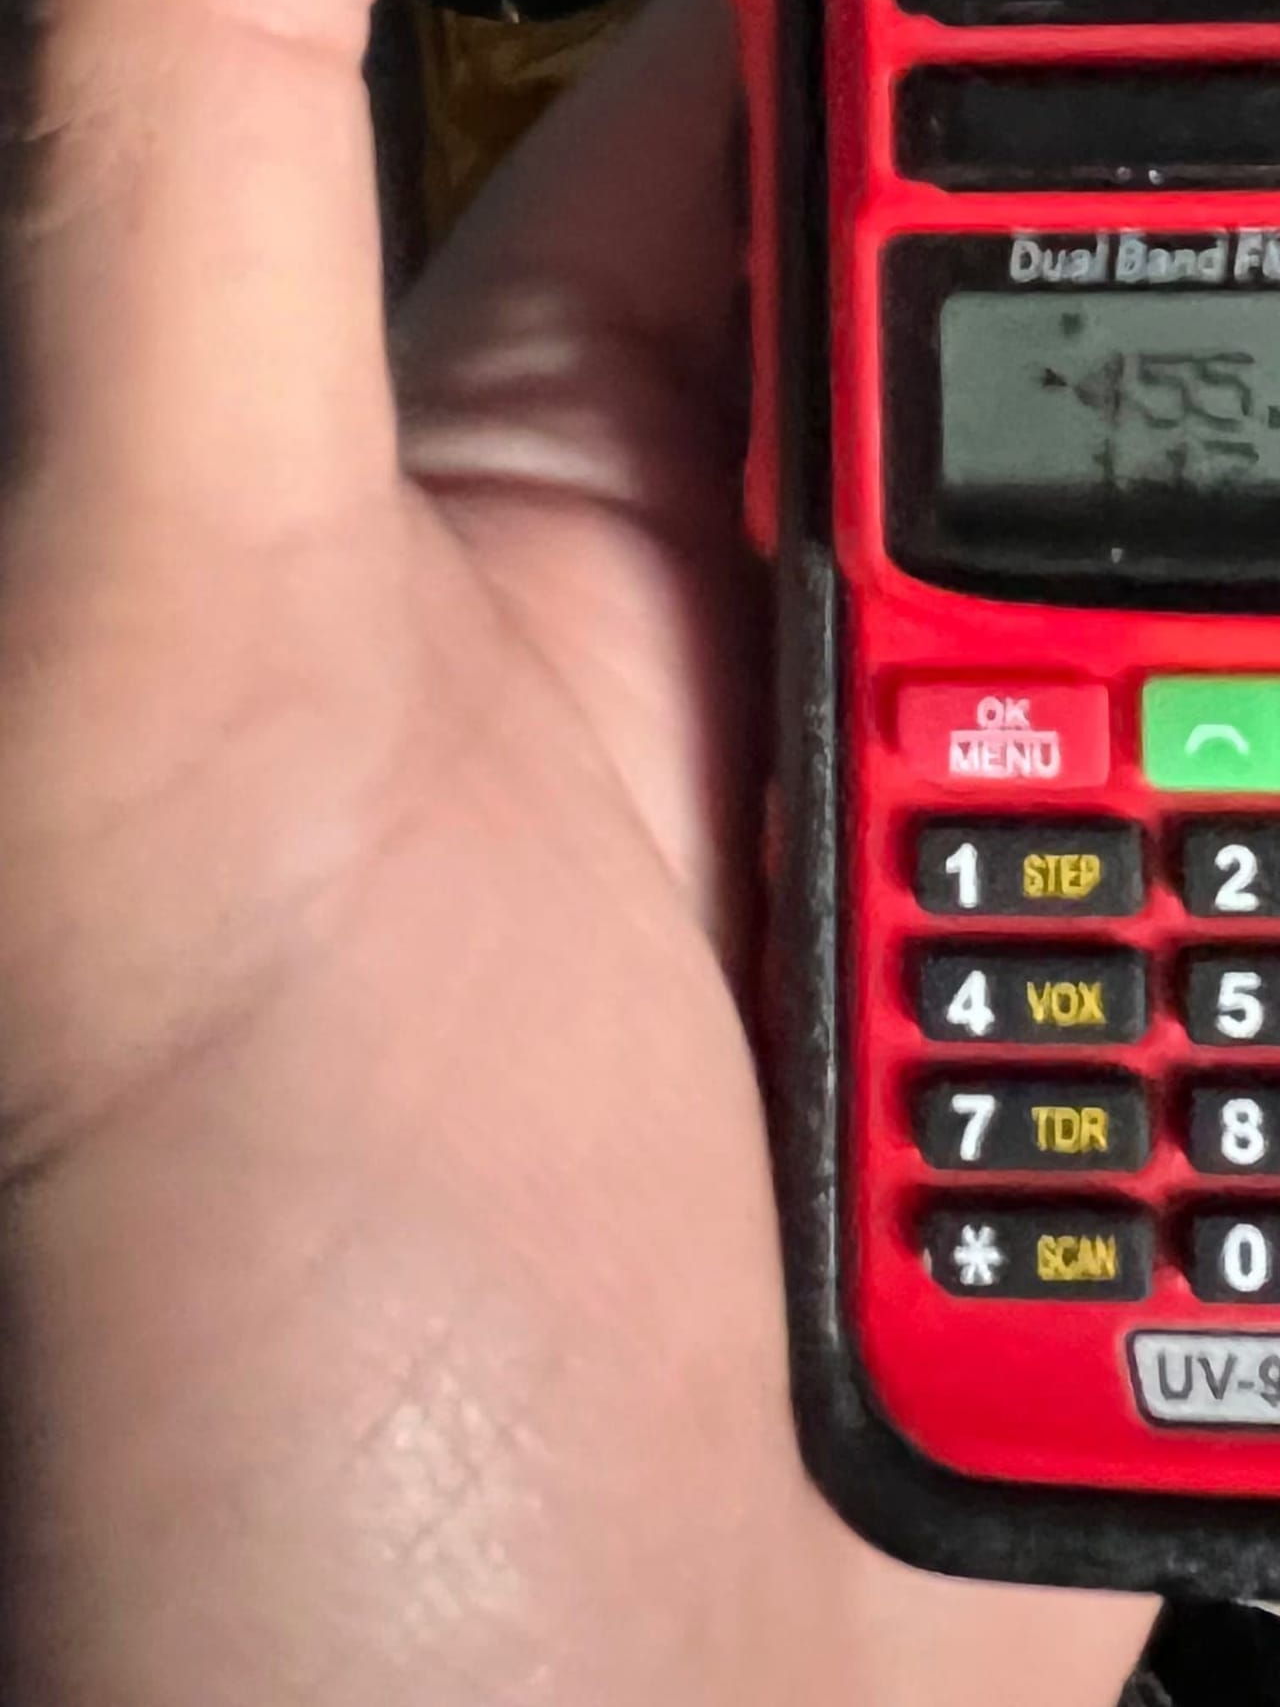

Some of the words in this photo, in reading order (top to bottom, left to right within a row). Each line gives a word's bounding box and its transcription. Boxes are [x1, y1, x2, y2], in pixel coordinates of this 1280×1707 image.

[1009, 228, 1108, 283] Dual
[1114, 228, 1224, 283] Band
[976, 696, 1031, 729] OK
[949, 740, 1061, 778] MENU
[945, 842, 979, 909] 1
[1022, 853, 1101, 899] STEP
[1214, 844, 1259, 911] 2
[945, 970, 995, 1036] 4
[1026, 981, 1104, 1026] VOX
[1216, 971, 1264, 1038] 5
[951, 1093, 996, 1162] 7
[1032, 1105, 1109, 1153] TDR
[1219, 1097, 1268, 1165] 8
[1036, 1234, 1117, 1282] SCAN
[1220, 1223, 1272, 1292] 0
